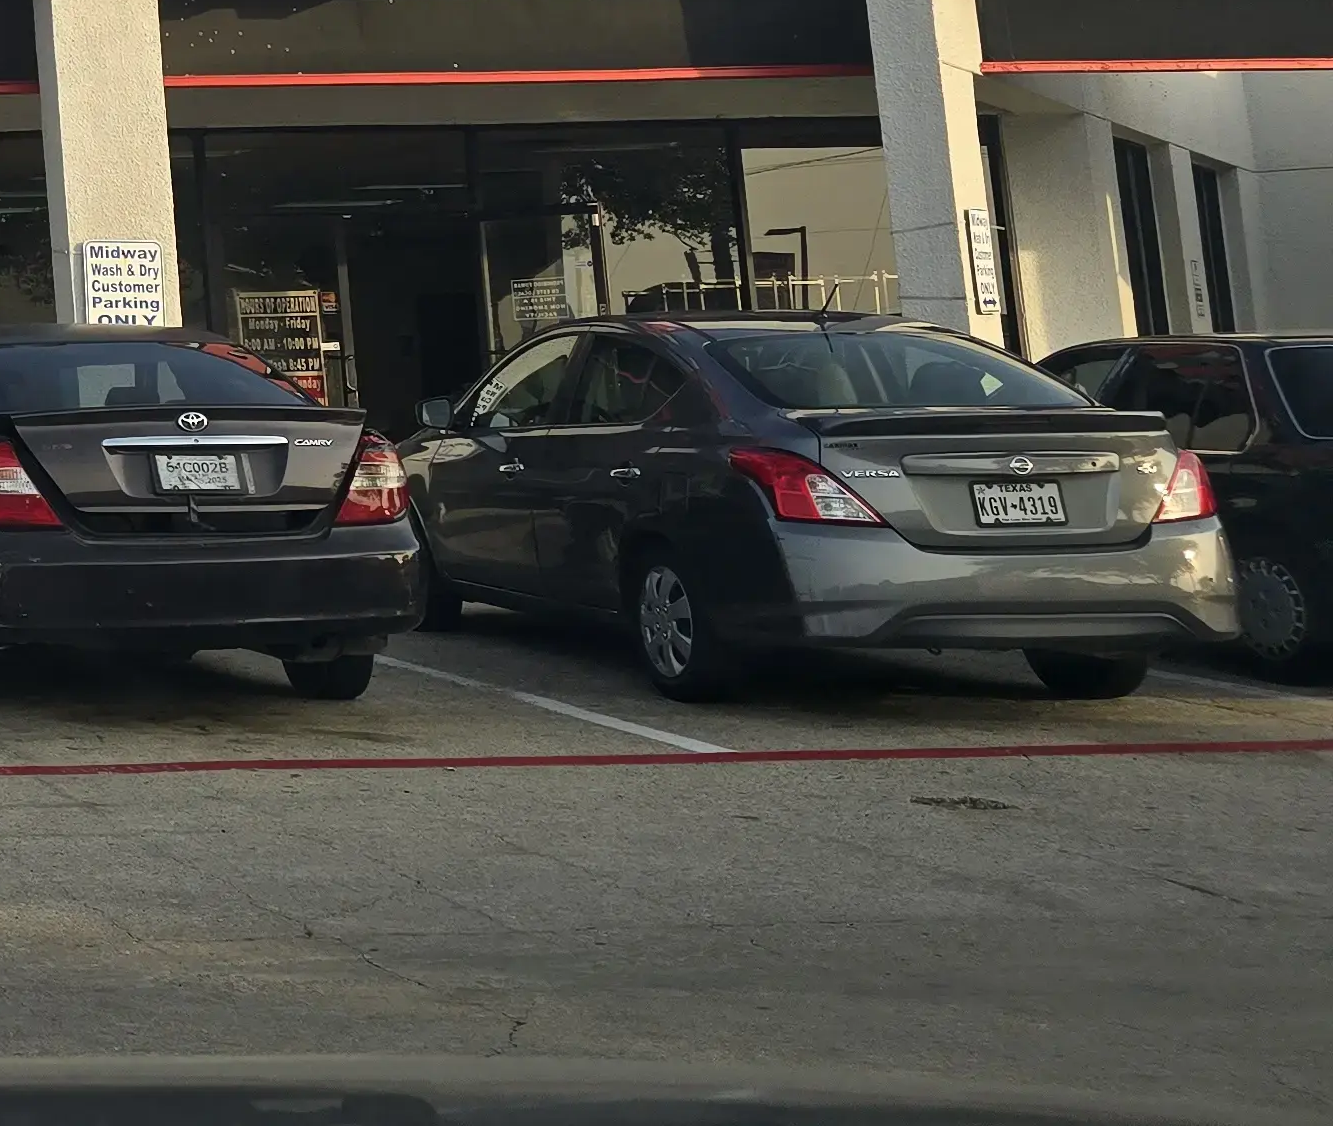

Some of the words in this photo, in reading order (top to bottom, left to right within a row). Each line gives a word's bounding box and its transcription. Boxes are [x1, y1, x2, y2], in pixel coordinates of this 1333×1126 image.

[89, 246, 158, 262] Midway
[91, 263, 122, 276] Wash
[127, 263, 135, 276] &
[139, 264, 159, 280] Dry
[976, 264, 994, 279] Parking
[91, 279, 160, 293] Customer
[980, 282, 996, 294] ONLY
[92, 296, 160, 312] Parking
[265, 298, 274, 314] OF
[276, 296, 316, 313] OPERATION
[248, 317, 278, 332] Monday
[285, 317, 310, 331] Friday
[263, 338, 275, 350] AM
[283, 337, 304, 350] 10:00
[306, 337, 318, 349] PM
[288, 358, 306, 371] 8:45
[308, 357, 320, 370] PM
[293, 438, 333, 446] CAMRY
[840, 469, 900, 478] VERSA
[998, 483, 1032, 493] TEXAS
[978, 496, 1008, 517] KGV
[1018, 495, 1059, 516] 4319
